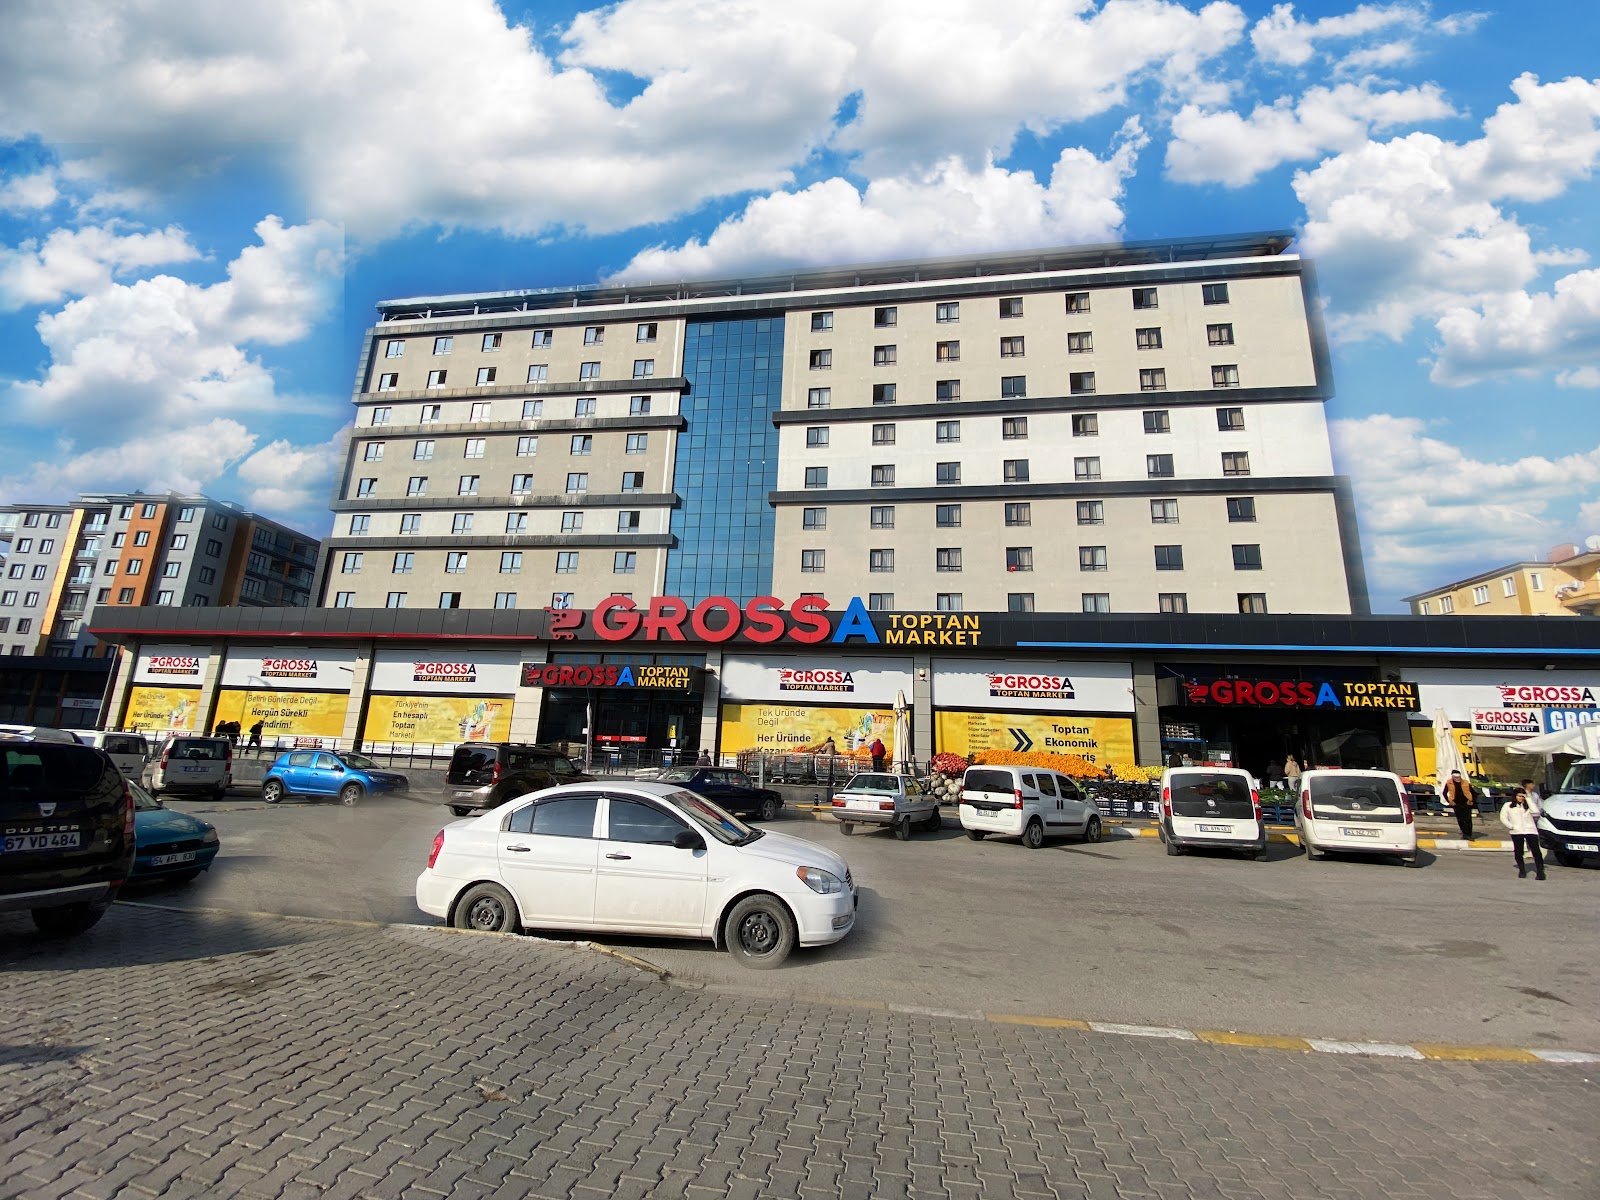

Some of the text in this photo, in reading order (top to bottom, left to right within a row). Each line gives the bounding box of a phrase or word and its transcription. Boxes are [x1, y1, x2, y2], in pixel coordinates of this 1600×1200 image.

[592, 596, 880, 643] GROSSA
[888, 614, 980, 631] TOPTAN
[885, 629, 982, 646] MARKET
[158, 657, 200, 668] GROSSA
[272, 660, 318, 671] GROSSA
[425, 663, 477, 675] GROSSA
[639, 666, 689, 678] TOPTAN
[541, 665, 635, 687] GROSSA
[637, 676, 690, 688] MARKET
[793, 670, 854, 684] GROSSA
[1004, 675, 1074, 690] GROSSA
[997, 689, 1068, 699] TOPTAN MARKET
[1210, 680, 1341, 707] GROSSA
[1343, 682, 1412, 696] TOPTAN
[1518, 687, 1596, 702] GROSSA
[267, 695, 299, 704] Günlerde
[395, 700, 429, 710] Türkiye'nin
[1344, 695, 1416, 709] MARKET
[251, 707, 308, 718] Hergün Sürekli
[402, 711, 428, 721] hesaplı
[758, 706, 806, 717] Tek Üründe
[1485, 711, 1539, 724] GROSSA
[391, 720, 416, 730] Toptan
[757, 717, 779, 728] Değil
[1051, 724, 1089, 736] Toptan
[757, 731, 812, 742] Her Üründe
[1045, 737, 1098, 748] Ekonomik
[5, 824, 80, 834] DUSTER
[5, 834, 77, 850] 67 VD 484
